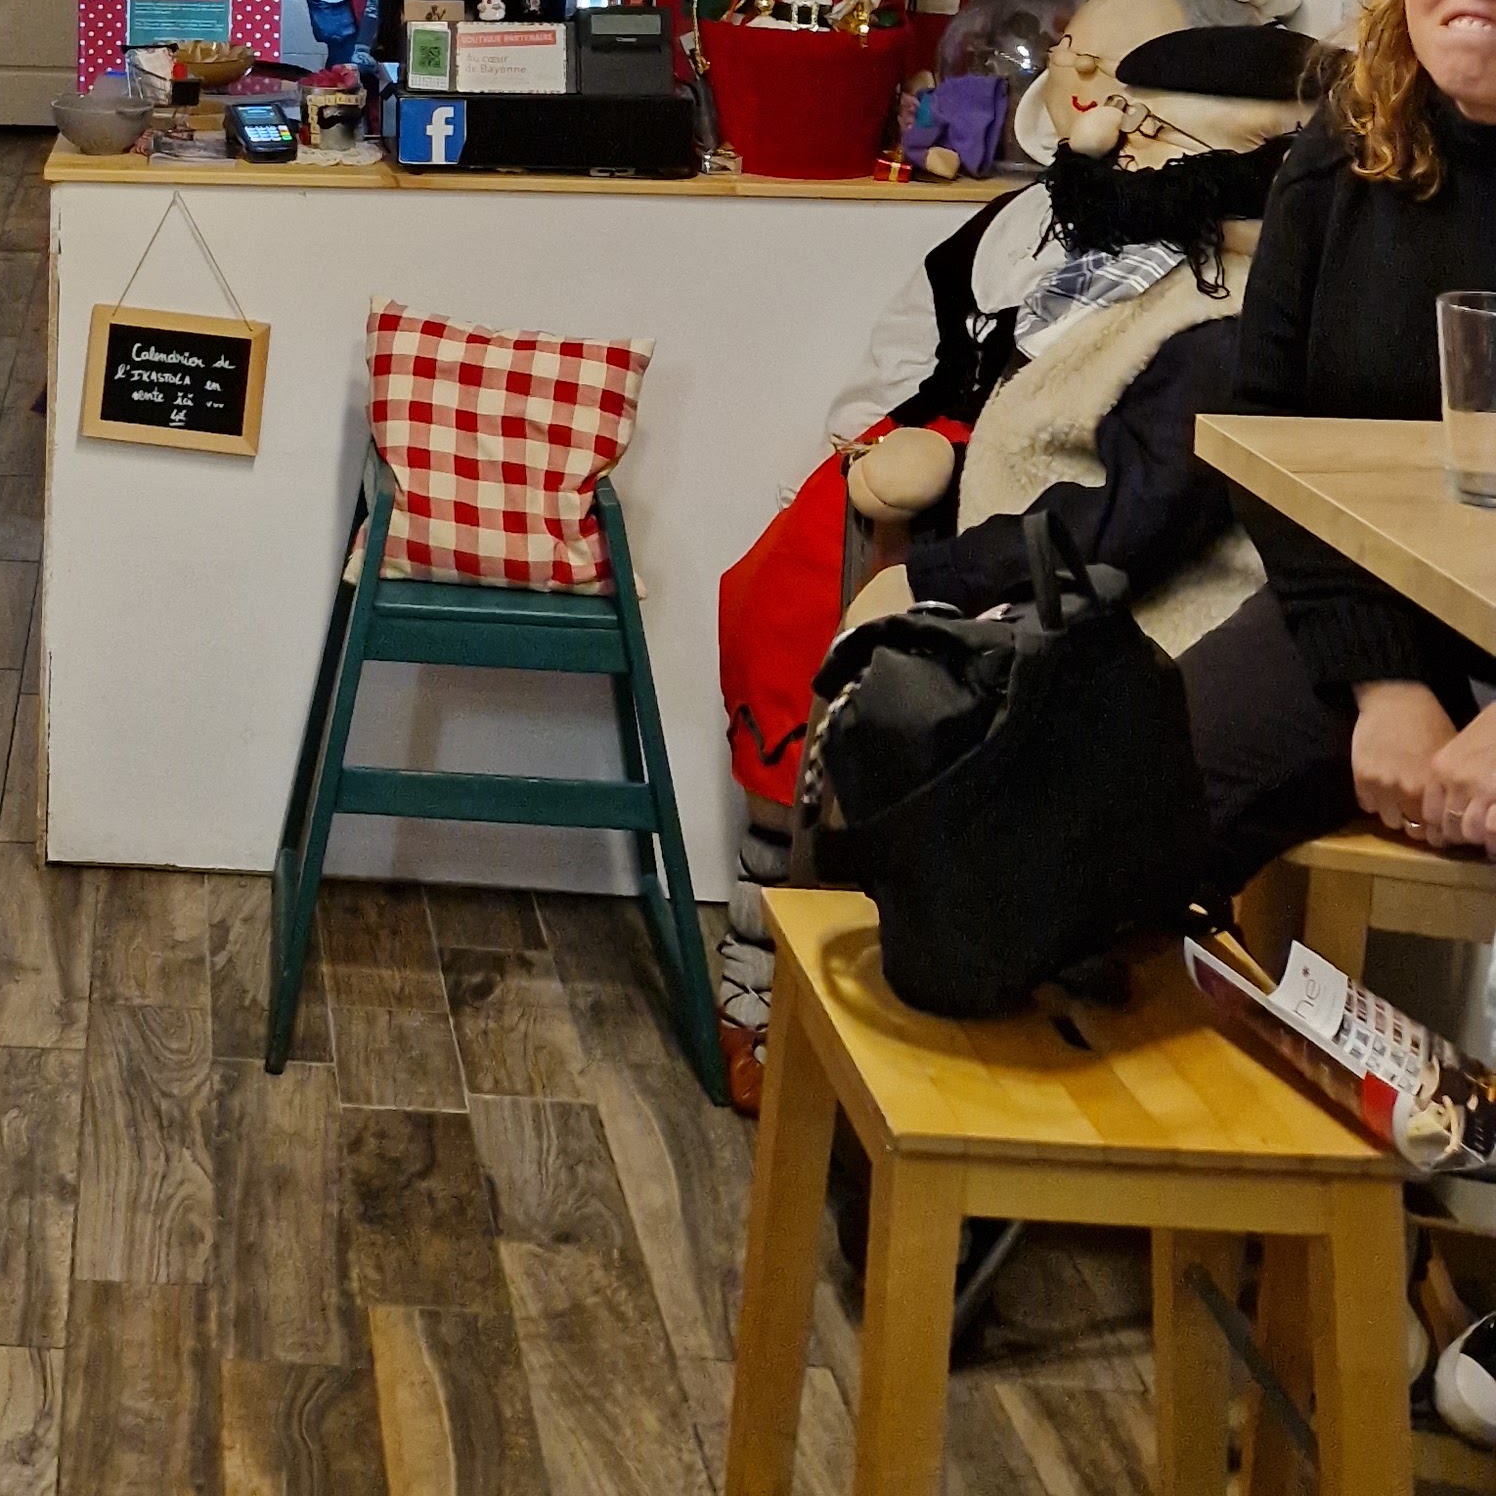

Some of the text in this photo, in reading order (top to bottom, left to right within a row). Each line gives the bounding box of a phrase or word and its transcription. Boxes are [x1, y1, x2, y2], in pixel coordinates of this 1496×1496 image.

[479, 64, 528, 76] Bayonne
[212, 354, 237, 370] de
[204, 380, 222, 392] en
[131, 386, 194, 407] vente ici
